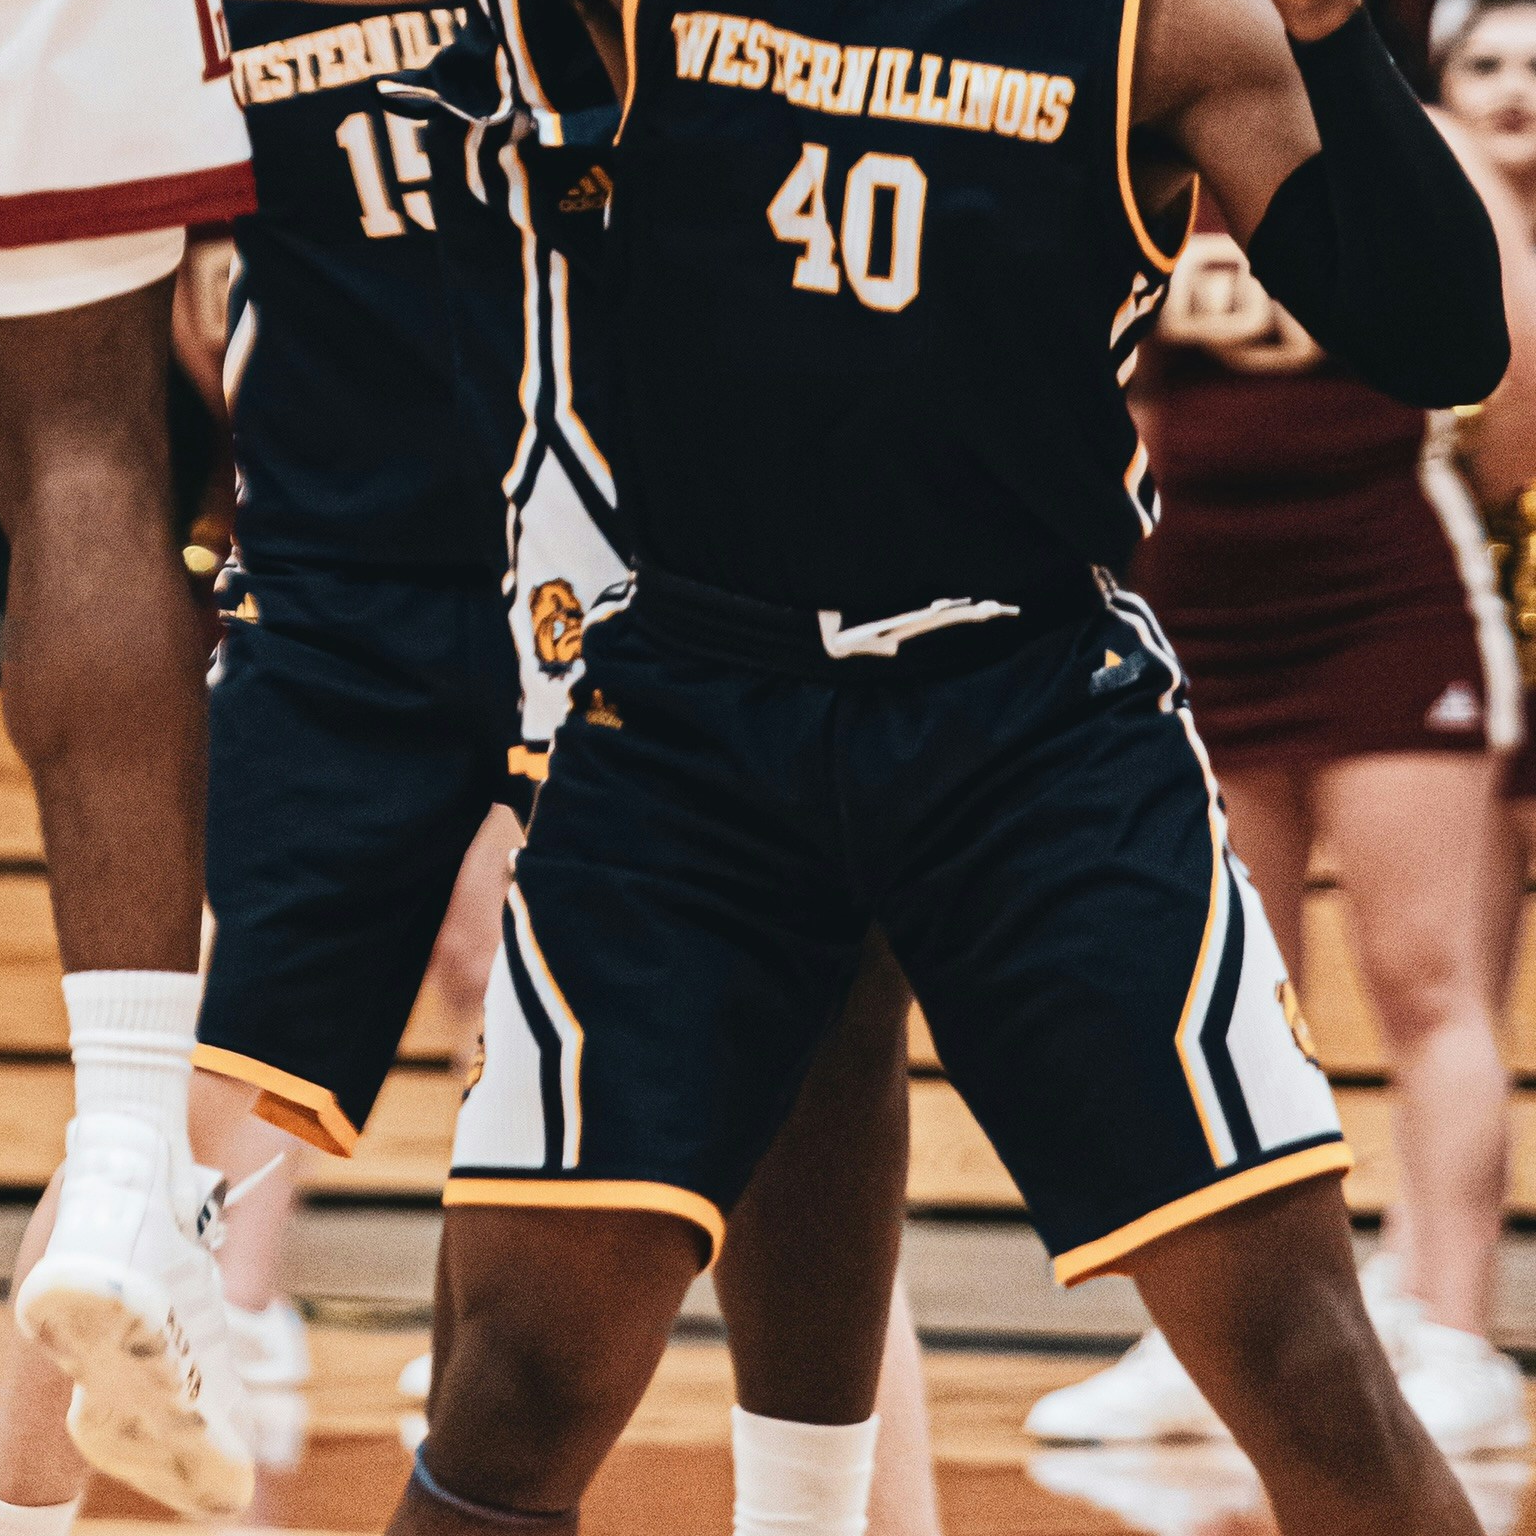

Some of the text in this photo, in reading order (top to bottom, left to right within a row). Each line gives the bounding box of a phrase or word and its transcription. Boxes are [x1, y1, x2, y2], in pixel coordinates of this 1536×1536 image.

[230, 21, 402, 106] ESTERN
[670, 10, 1076, 144] WESTERN ILLINOIS
[766, 141, 928, 314] 40
